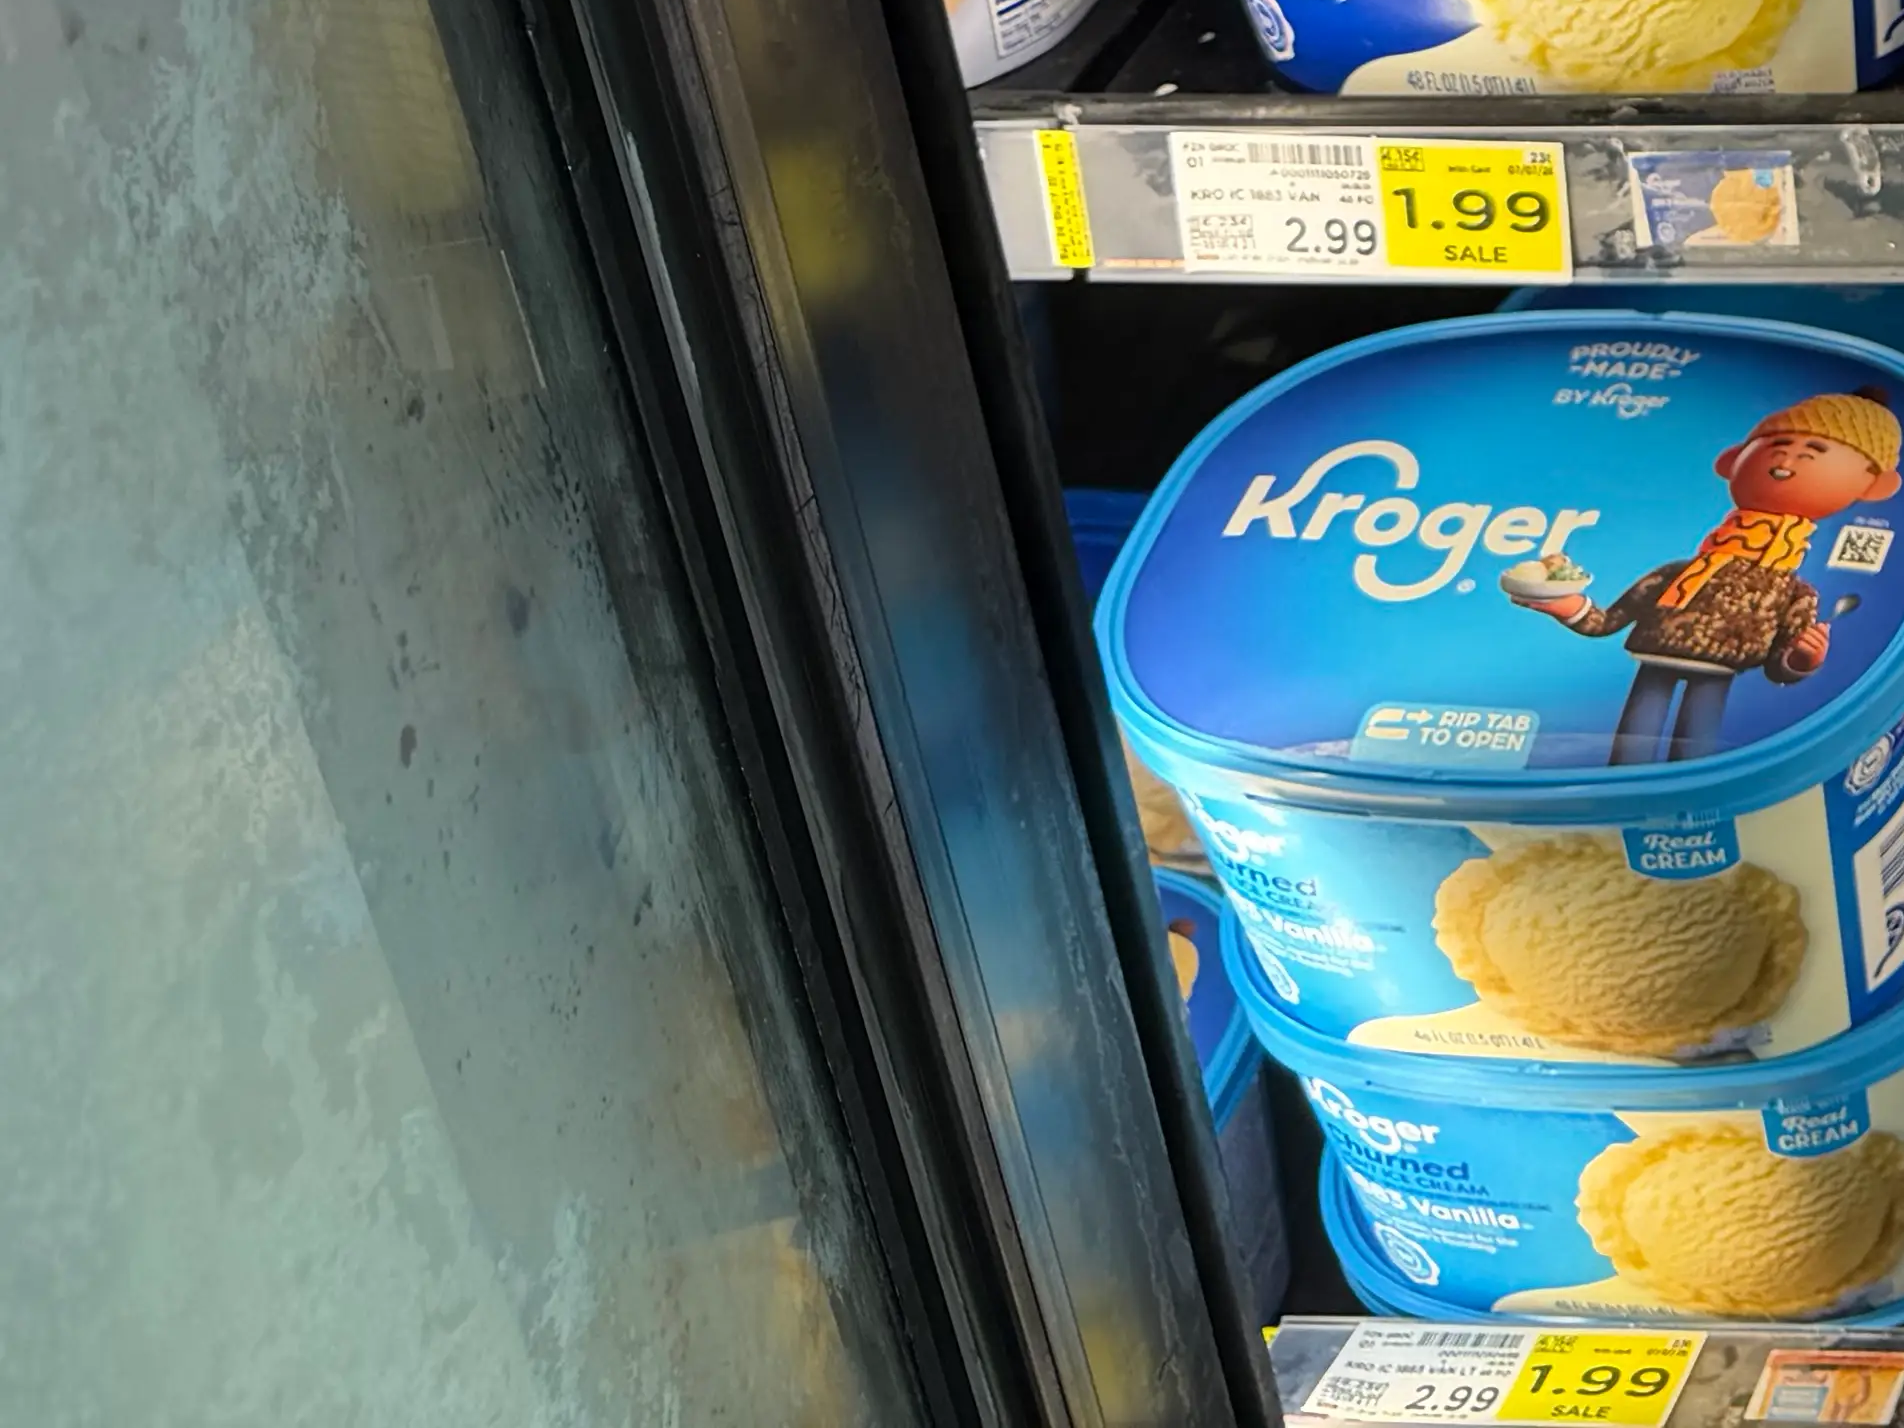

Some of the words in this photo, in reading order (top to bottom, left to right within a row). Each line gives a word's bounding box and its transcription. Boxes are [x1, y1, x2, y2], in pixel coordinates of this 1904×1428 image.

[1392, 187, 1550, 233] 1.99
[1285, 217, 1377, 256] 2.99
[1445, 245, 1507, 263] SALE
[1570, 341, 1700, 369] PROUDLY
[1223, 439, 1602, 603] Kroger
[1526, 1364, 1670, 1399] 1.99
[1405, 1385, 1500, 1415] 2.99
[1551, 1403, 1612, 1421] SALE
